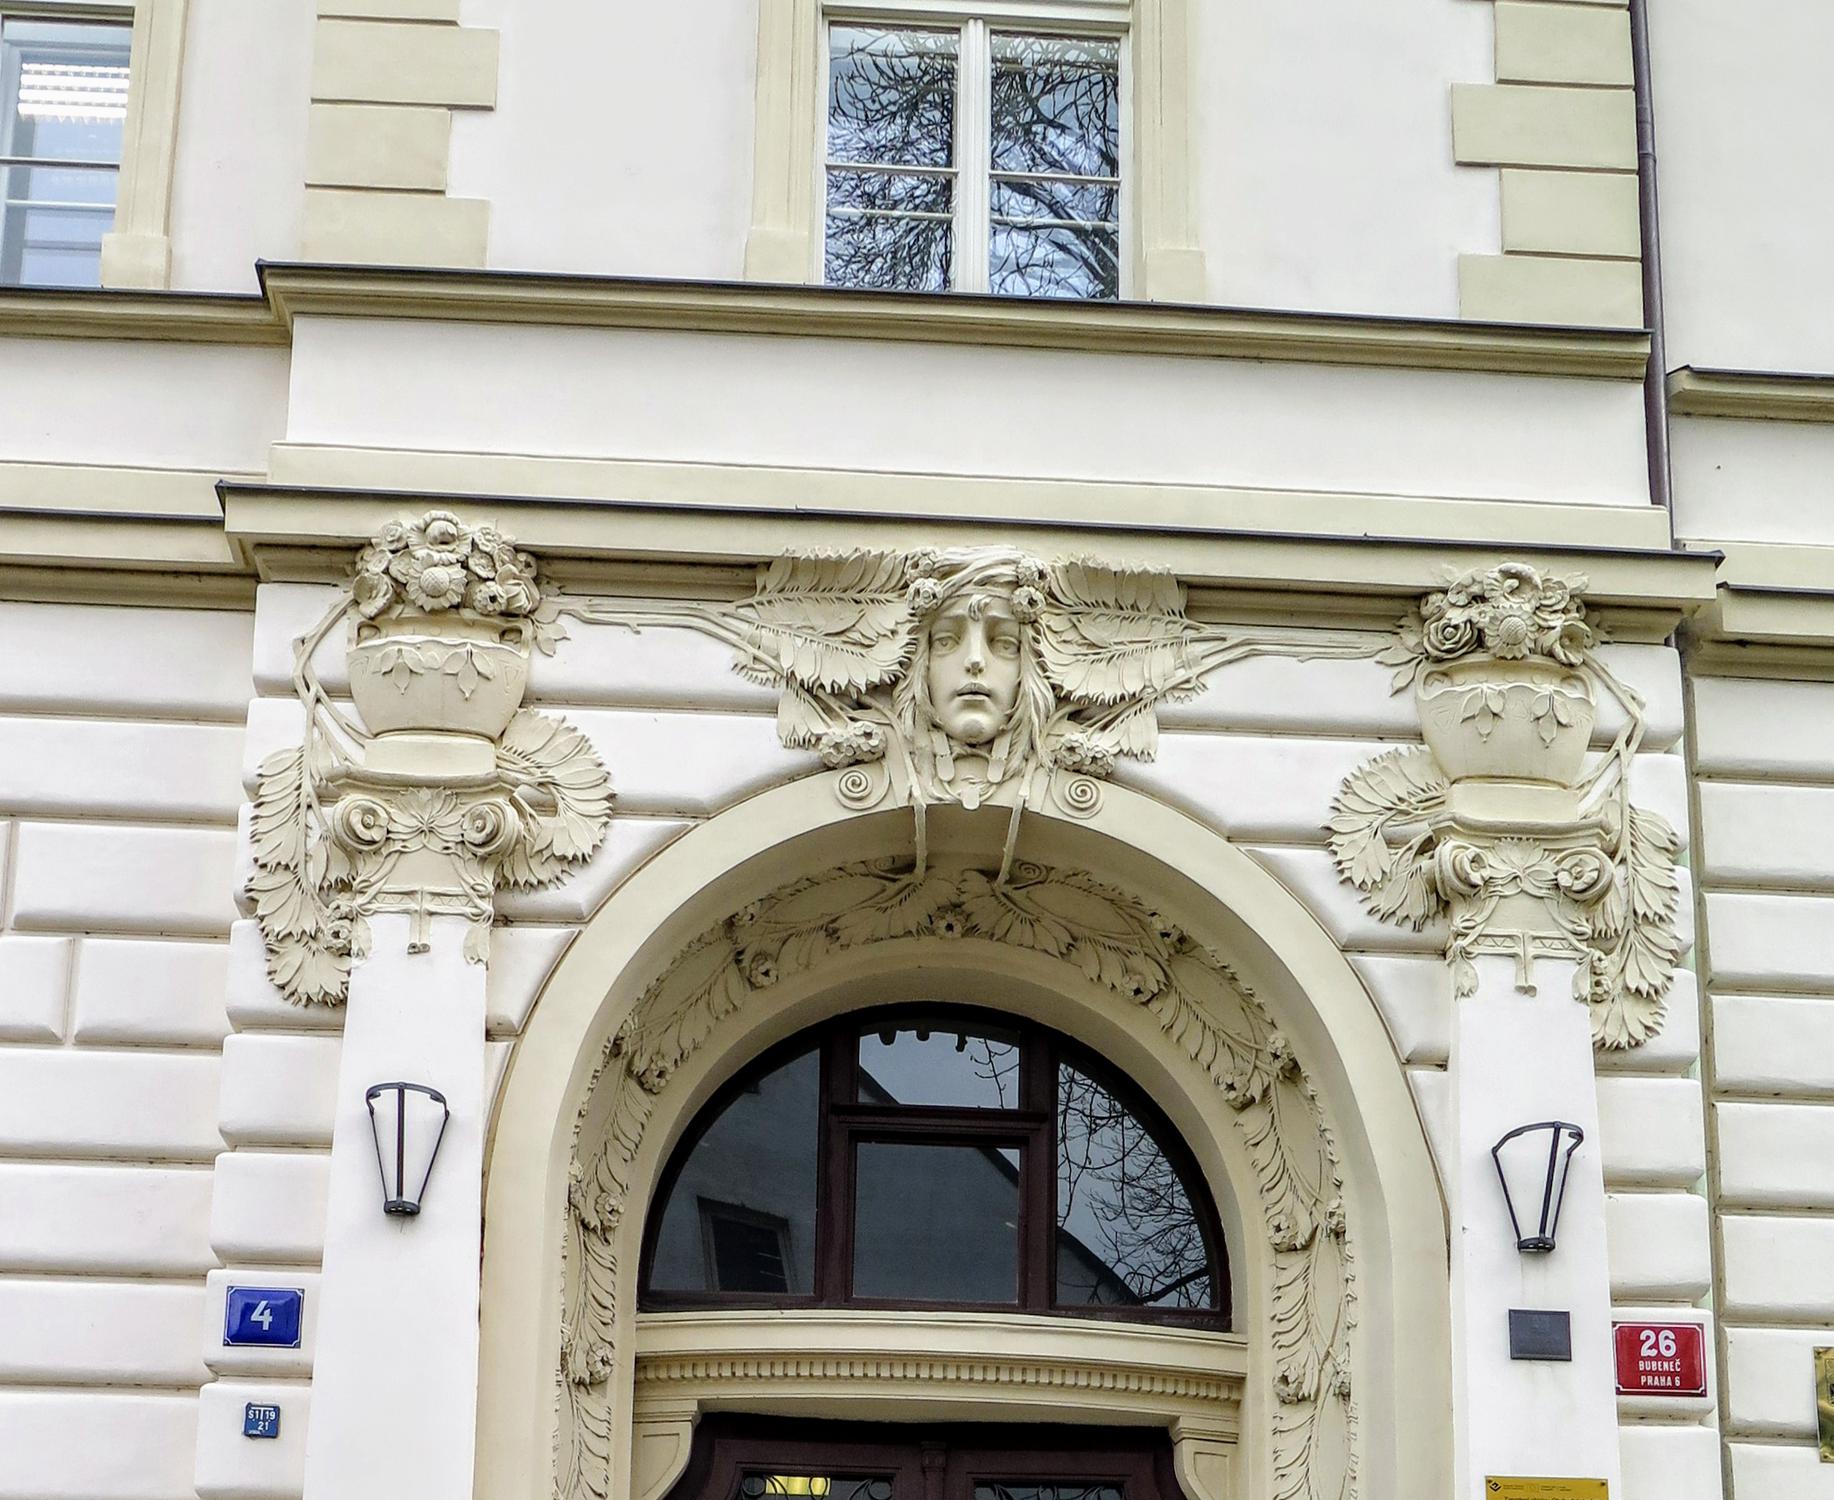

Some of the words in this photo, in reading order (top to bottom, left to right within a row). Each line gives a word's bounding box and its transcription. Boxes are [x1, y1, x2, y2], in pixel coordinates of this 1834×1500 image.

[250, 1300, 273, 1331] 4
[1639, 1329, 1677, 1358] 26
[1638, 1359, 1681, 1372] BUBENEČ
[1640, 1375, 1673, 1387] PRAHA
[1674, 1376, 1681, 1387] 6
[257, 1421, 269, 1431] 21
